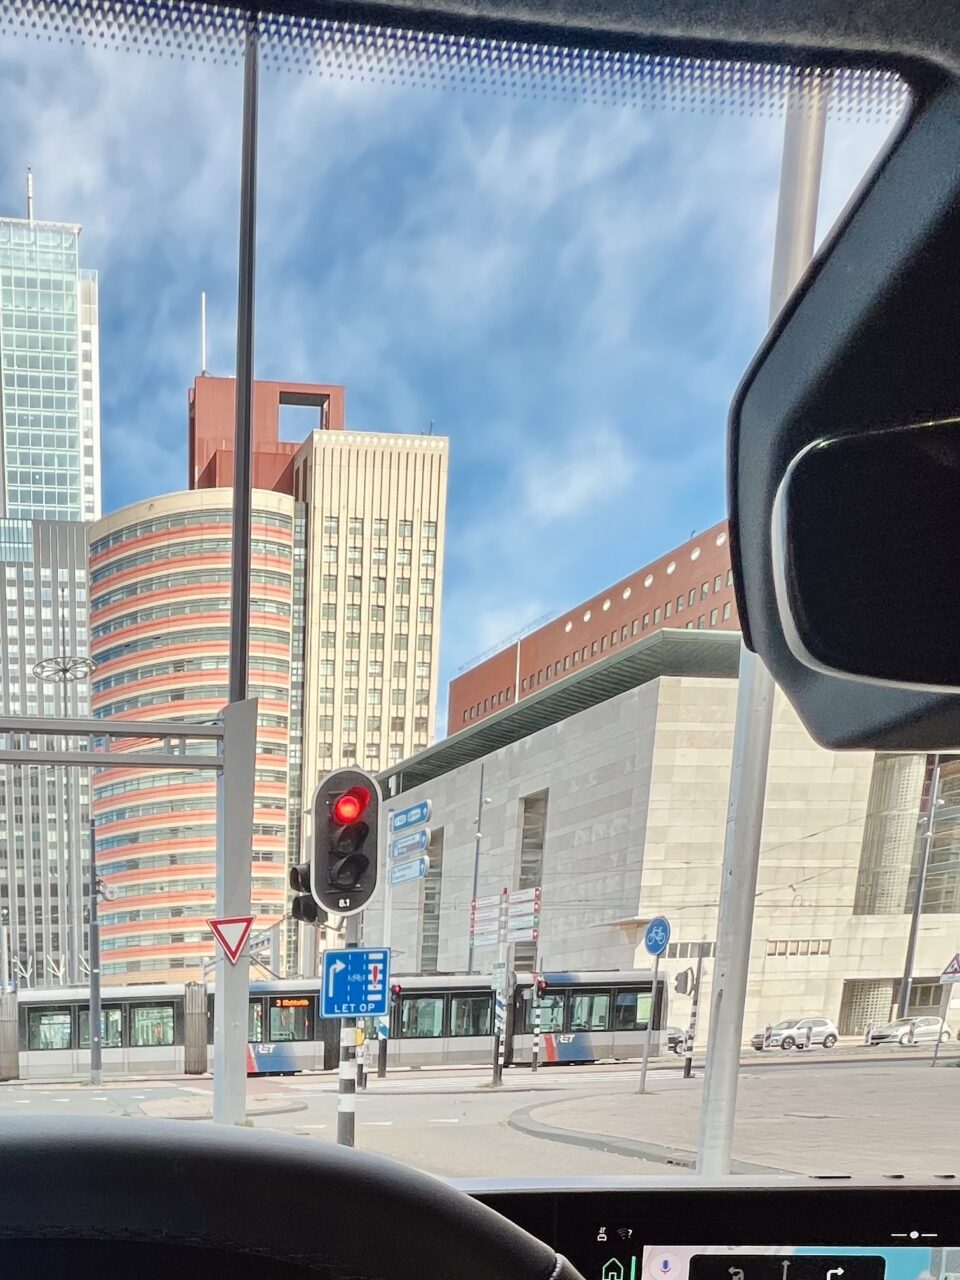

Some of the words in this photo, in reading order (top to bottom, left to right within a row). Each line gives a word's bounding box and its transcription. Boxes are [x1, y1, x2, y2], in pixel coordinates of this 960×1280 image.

[338, 899, 350, 908] 8.1
[334, 1004, 356, 1013] LET
[359, 1003, 375, 1012] OP
